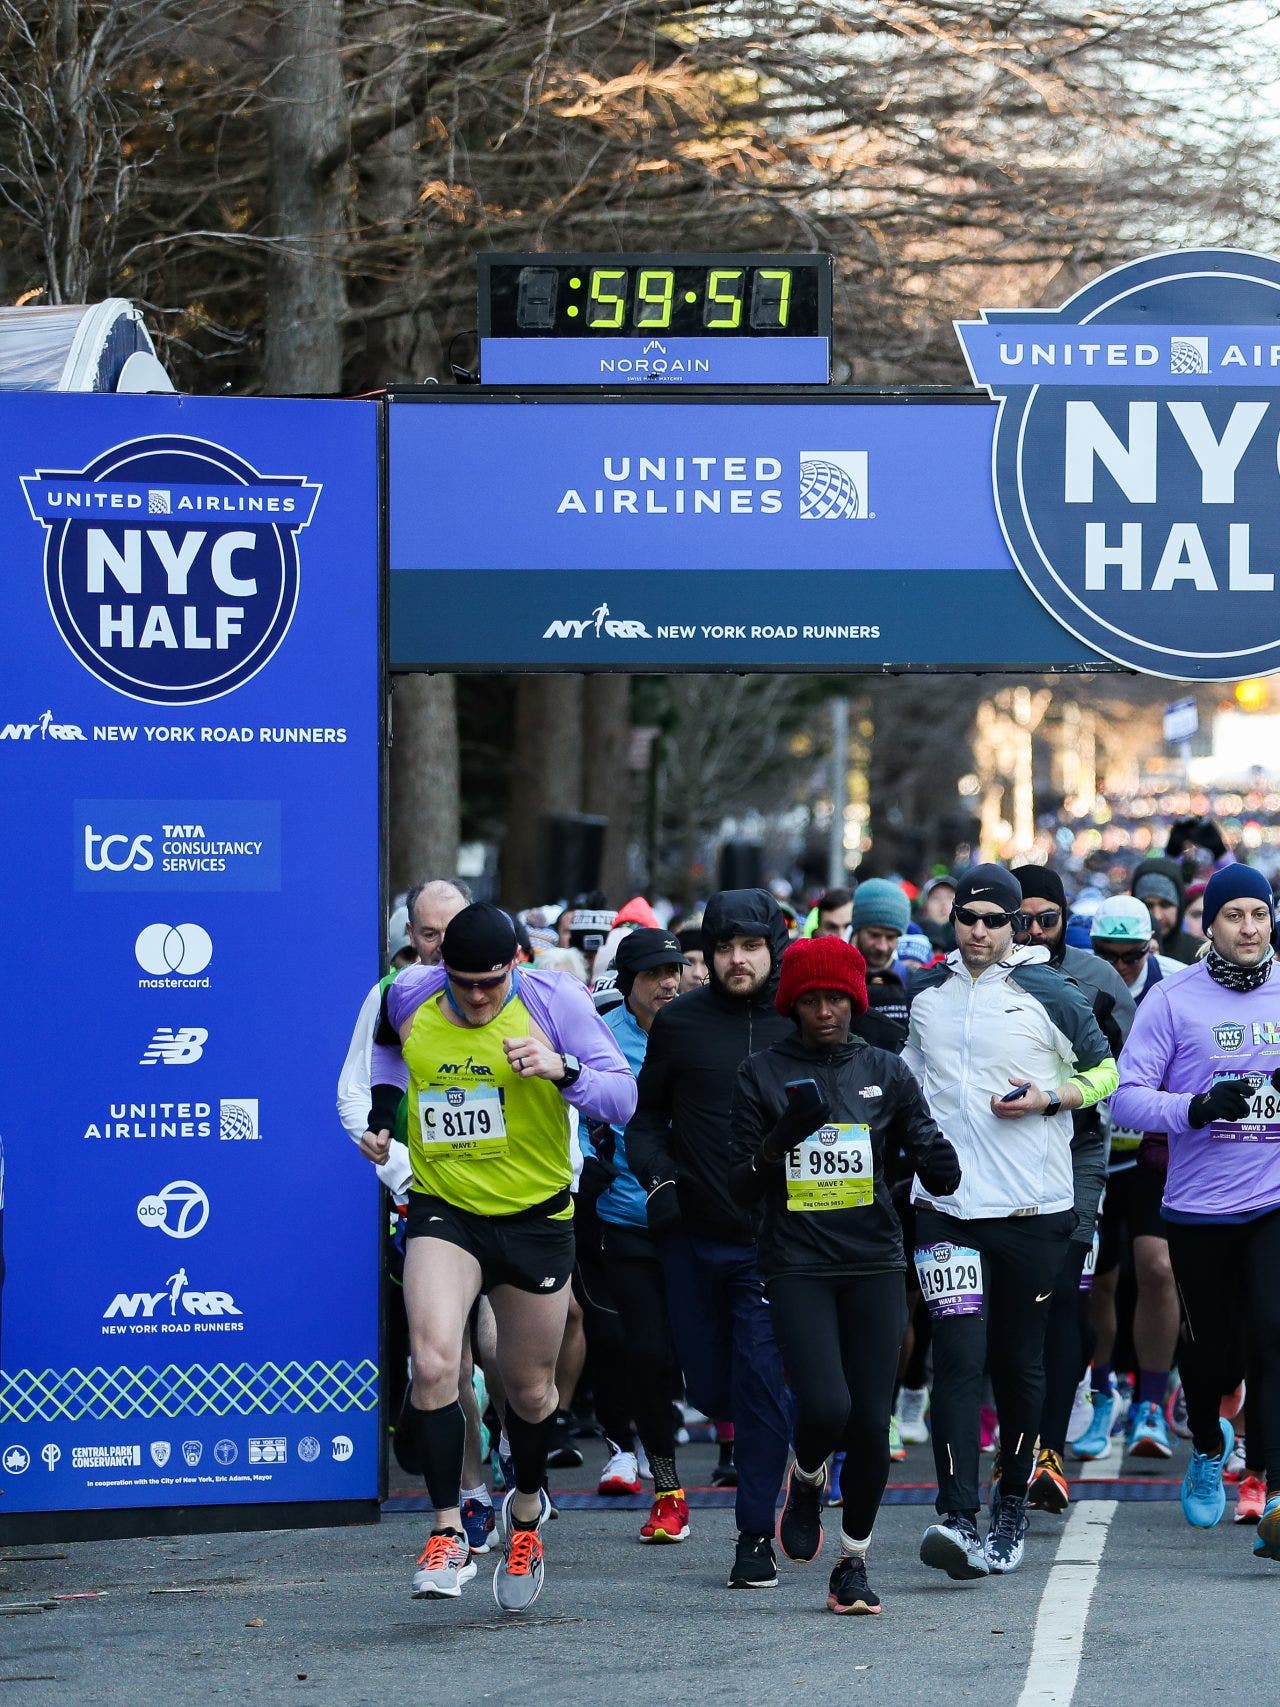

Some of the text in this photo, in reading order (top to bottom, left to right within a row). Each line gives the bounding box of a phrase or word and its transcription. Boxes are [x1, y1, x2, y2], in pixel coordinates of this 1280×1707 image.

[1000, 344, 1160, 366] UNITED
[600, 359, 710, 373] NORQAIN
[603, 457, 782, 481] UNITED
[47, 492, 296, 512] UNITED AIRLINES
[557, 489, 782, 514] AIRLINES
[86, 528, 258, 597] NYC
[99, 604, 245, 649] HALF
[657, 625, 696, 639] NEW
[701, 625, 746, 639] YORK
[751, 625, 798, 639] ROAD
[803, 625, 881, 639] RUNNERS
[93, 727, 138, 741] NEW
[147, 727, 196, 742] YORK
[201, 728, 253, 742] ROAD
[259, 728, 347, 743] RUNNERS
[162, 825, 206, 838] TATA
[85, 824, 154, 872] tcs
[162, 841, 263, 855] CONSULTANCY
[162, 858, 226, 872] SERVICES
[1218, 1030, 1241, 1039] NYC
[110, 1103, 211, 1119] UNITED
[424, 1107, 491, 1137] C 8179
[84, 1123, 211, 1139] AIRLINES
[809, 1150, 863, 1175] 9853
[139, 1205, 165, 1217] abc
[926, 1265, 978, 1295] 19129
[938, 1297, 957, 1305] WAVE
[102, 1322, 244, 1334] NEW YORK ROAD RUNNERS
[72, 1445, 133, 1458] CENTRAL PARK
[332, 1442, 350, 1455] MTA
[72, 1456, 133, 1468] CONSERVANCY
[95, 1479, 133, 1488] cooperation
[134, 1478, 148, 1486] with
[161, 1477, 174, 1485] City
[253, 1474, 272, 1482] Mayor
